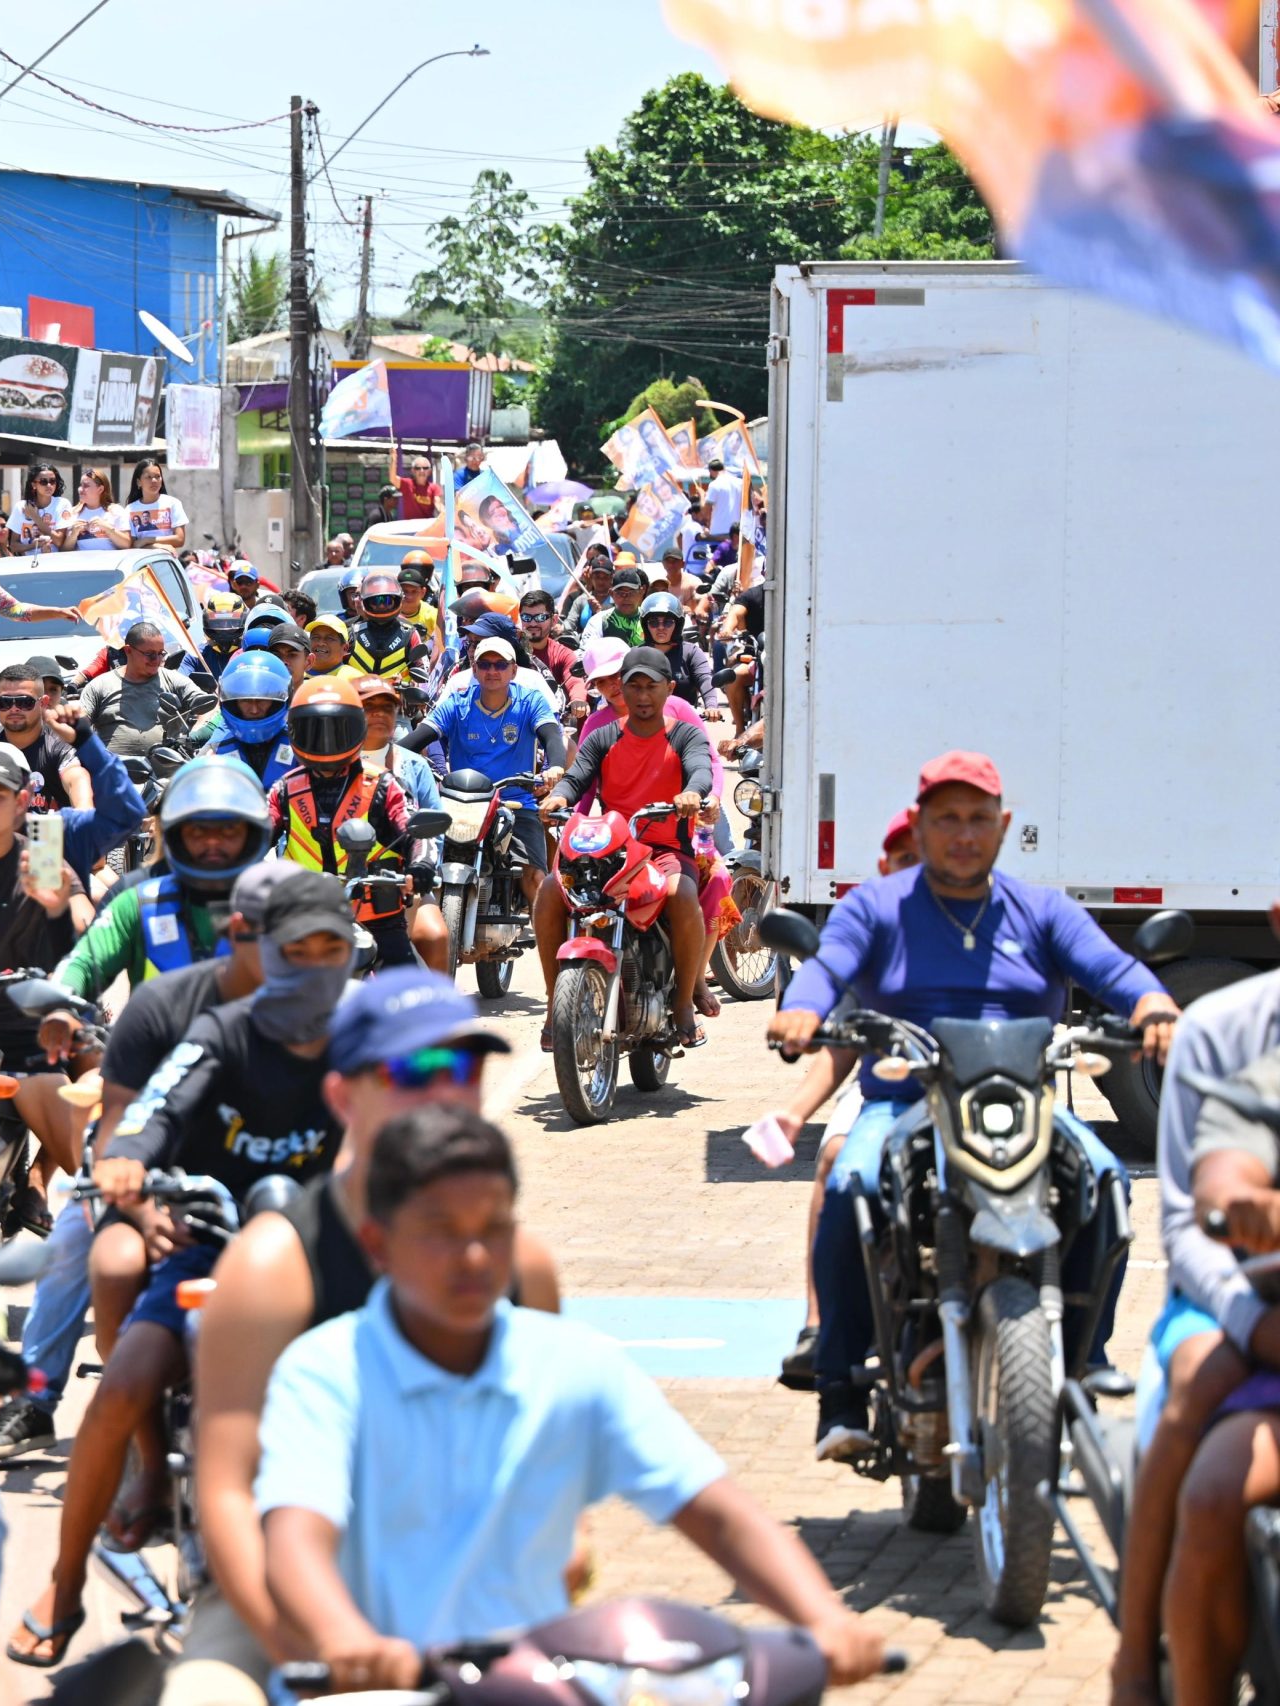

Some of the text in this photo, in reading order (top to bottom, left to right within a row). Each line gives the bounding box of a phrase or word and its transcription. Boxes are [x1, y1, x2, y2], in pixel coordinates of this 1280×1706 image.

[359, 632, 402, 651] MOTO TAXI
[296, 797, 312, 825] MOTO
